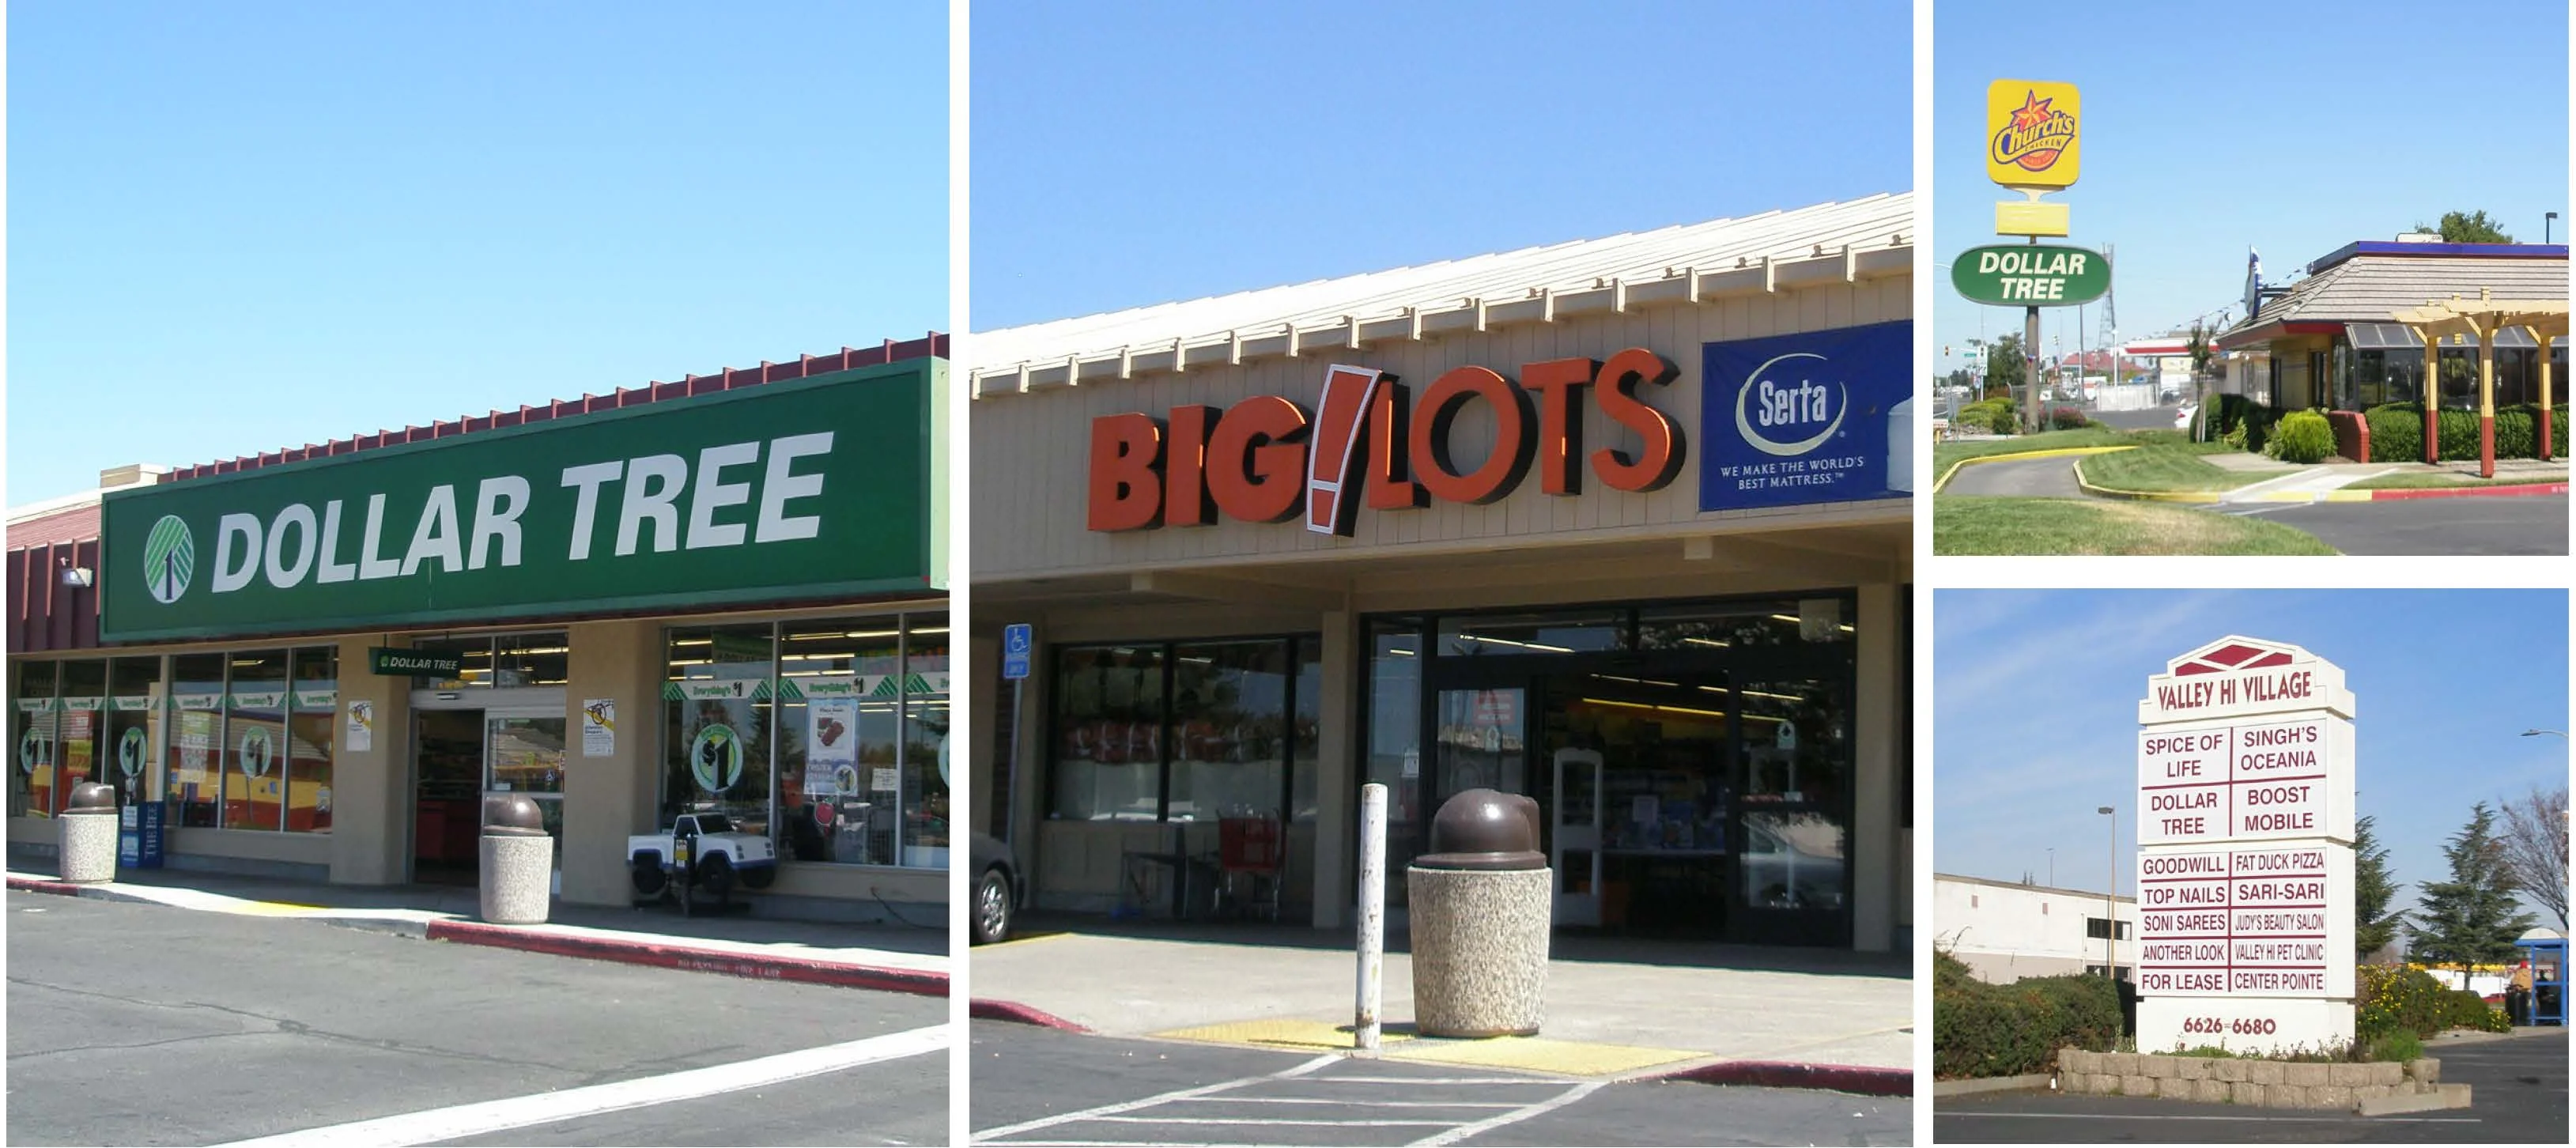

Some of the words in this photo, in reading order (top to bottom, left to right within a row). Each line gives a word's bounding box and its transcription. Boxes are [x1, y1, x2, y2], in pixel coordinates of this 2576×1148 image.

[1992, 110, 2076, 164] Church's
[1979, 251, 2086, 276] DOLLAR
[2000, 277, 2066, 300] TREE
[1758, 379, 1827, 427] Serta
[1369, 348, 1684, 510] LOTS
[1720, 466, 1739, 478] WE
[1743, 463, 1777, 476] MAKE
[1780, 461, 1804, 473] THE
[1809, 455, 1864, 470] WORLD'S
[1739, 477, 1765, 490] BEST
[211, 474, 531, 594] DOLLAR
[561, 431, 835, 561] TREE
[390, 656, 432, 669] DOLLAR
[434, 659, 458, 670] TREE
[2157, 681, 2214, 712] VALLEY
[2220, 678, 2237, 705] HI
[2243, 671, 2312, 703] VILLAGE
[2145, 736, 2195, 756] SPICE
[2200, 734, 2223, 751] OF
[2244, 726, 2317, 747] SINGH'S
[2166, 759, 2202, 778] LIFE
[2240, 750, 2317, 771] OCEANIA
[2151, 792, 2218, 811] DOLLAR
[2247, 786, 2310, 806] BOOST
[2161, 817, 2205, 836] TREE
[2245, 812, 2313, 832] MOBILE
[2143, 857, 2225, 875] GOODWILL
[2236, 854, 2256, 871] FAT
[2259, 853, 2289, 870] DUCK
[2292, 852, 2325, 870] PIZZA
[2144, 888, 2175, 904] TOP
[2179, 886, 2226, 904] NAILS
[2238, 883, 2325, 901] SARI-SARI
[2144, 915, 2173, 931] SONI
[2177, 914, 2226, 931] SAREES
[2235, 914, 2262, 931] JUDY'S
[2264, 914, 2295, 931] BEAUTY
[2297, 913, 2324, 931] SALON
[2143, 945, 2193, 961] ANOTHER
[2195, 945, 2225, 961] LOOK
[2235, 944, 2264, 961] VALLEY
[2267, 944, 2276, 960] HI
[2277, 944, 2293, 961] PET
[2295, 943, 2324, 961] CLINIC
[2142, 974, 2171, 990] FOR
[2176, 974, 2223, 990] LEASE
[2234, 973, 2279, 990] CENTER
[2282, 973, 2324, 990] POINTE
